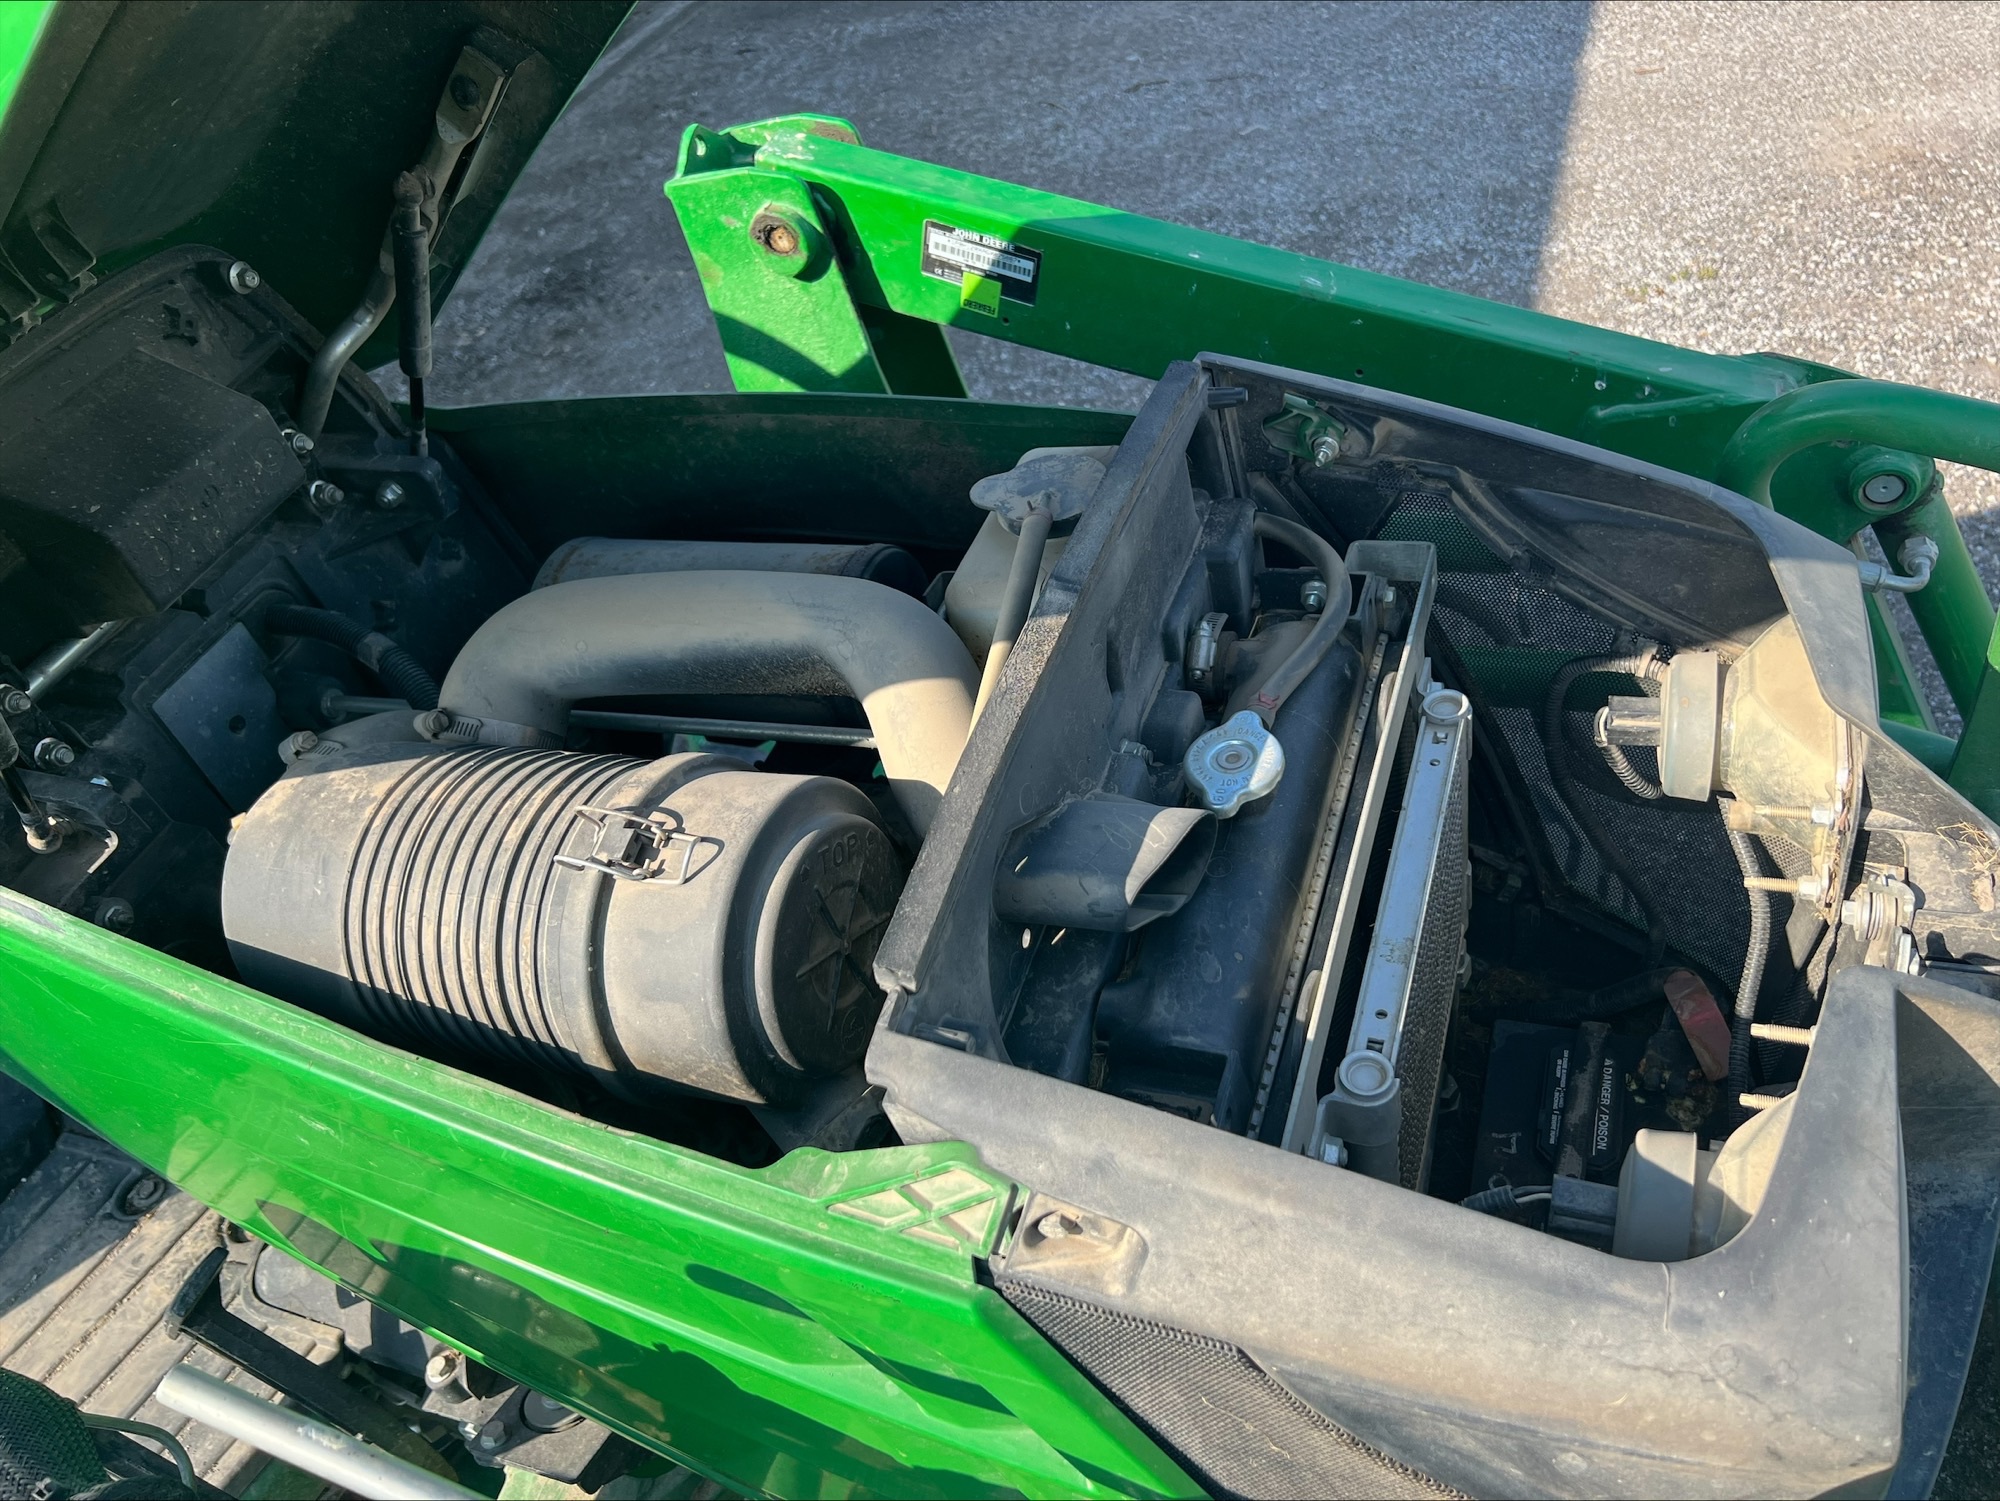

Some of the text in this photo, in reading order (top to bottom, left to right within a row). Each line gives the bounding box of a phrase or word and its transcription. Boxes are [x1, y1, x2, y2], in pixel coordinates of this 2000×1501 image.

[952, 228, 980, 243] JOHN
[982, 235, 1015, 252] DEERE
[1221, 779, 1238, 787] HOT
[818, 831, 857, 875] TOP
[1601, 1067, 1613, 1106] DANGER
[1596, 1114, 1609, 1151] POISON
